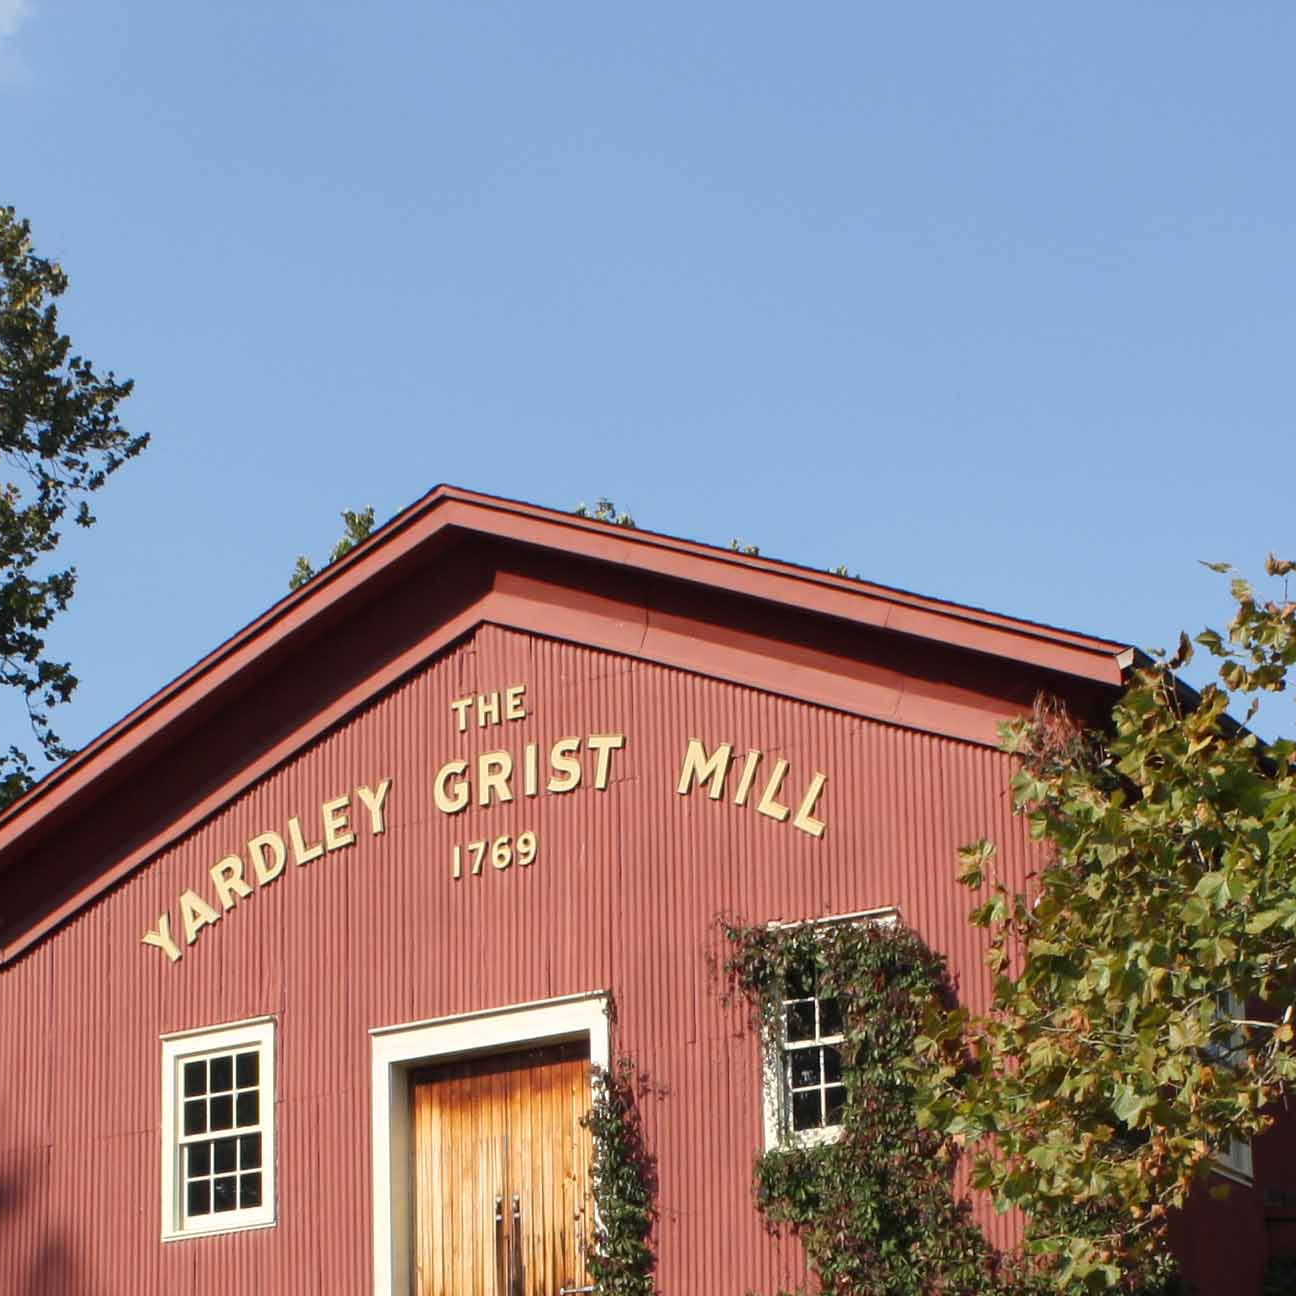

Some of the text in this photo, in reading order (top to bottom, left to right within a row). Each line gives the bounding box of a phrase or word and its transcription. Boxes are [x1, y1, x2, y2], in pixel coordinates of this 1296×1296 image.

[451, 685, 527, 732] THE
[141, 733, 827, 963] YARDLEY GRIST MILL
[452, 831, 538, 879] 1769
